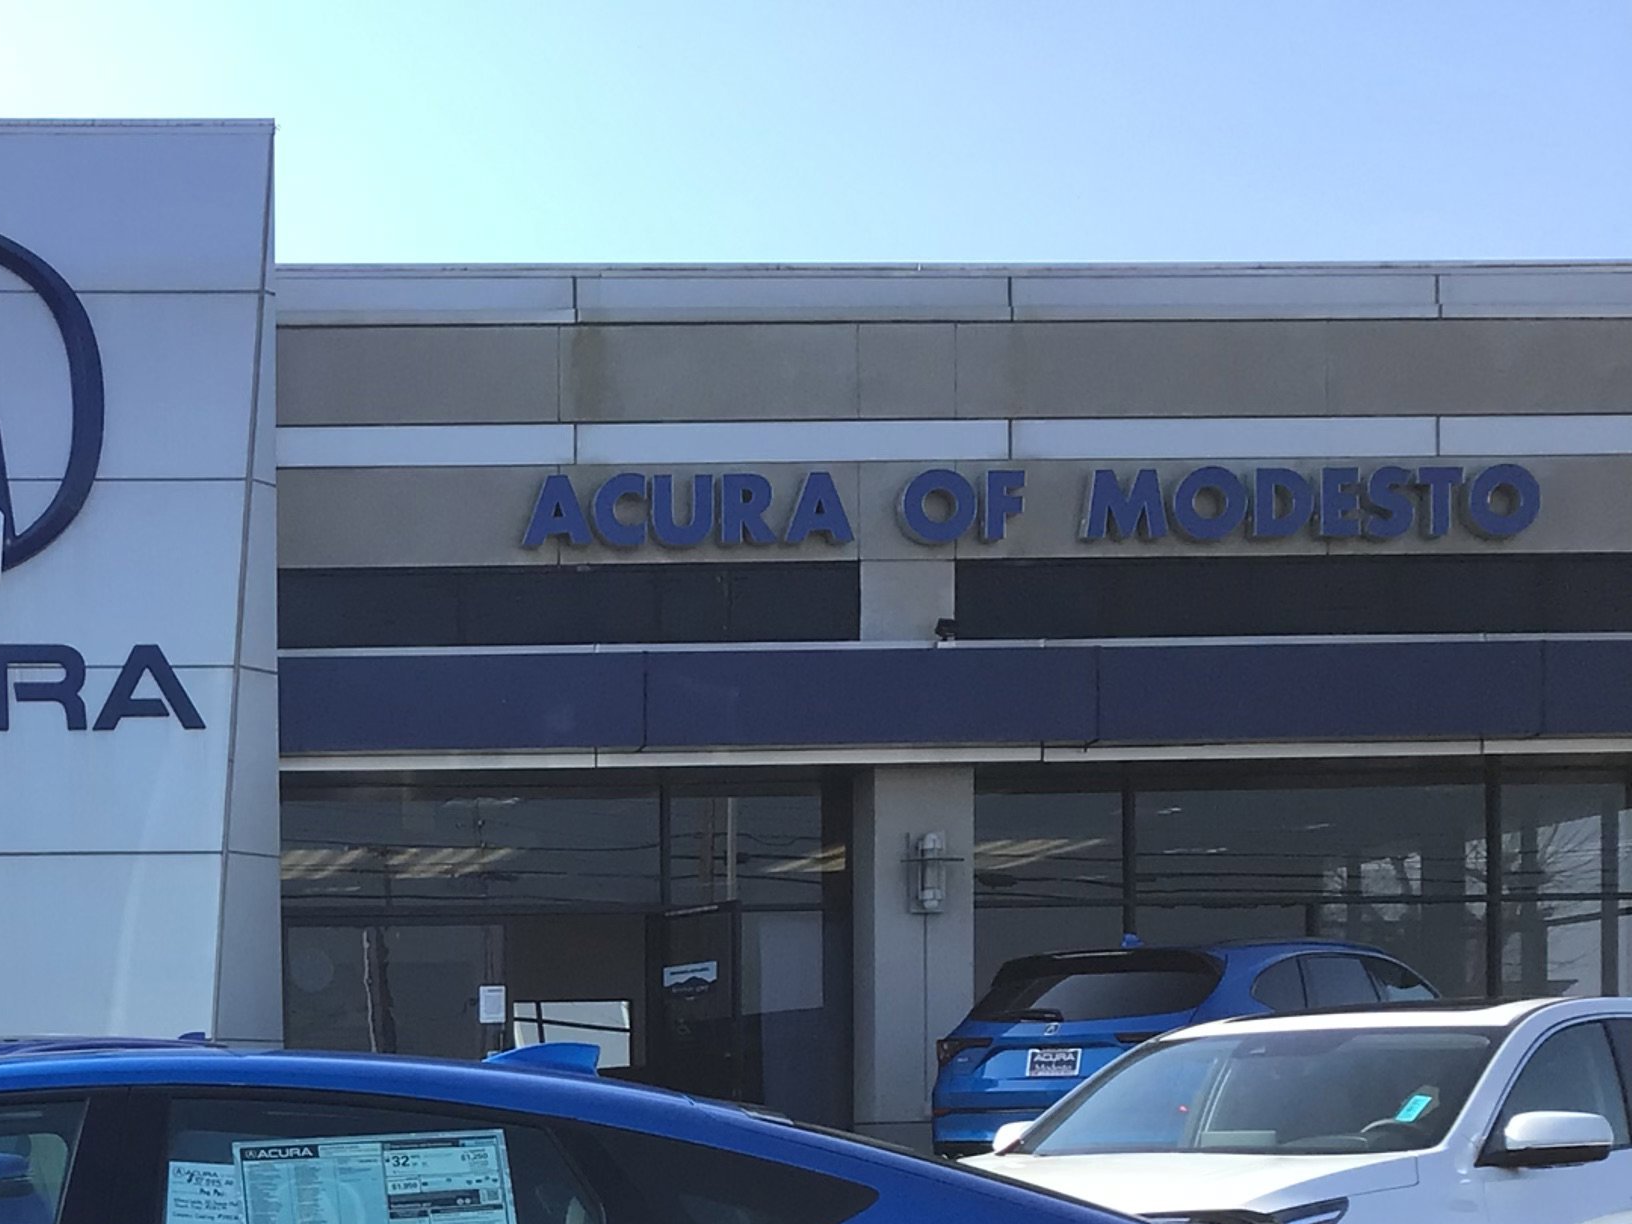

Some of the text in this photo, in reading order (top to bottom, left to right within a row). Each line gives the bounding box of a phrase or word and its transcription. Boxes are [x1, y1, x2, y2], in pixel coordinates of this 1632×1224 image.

[522, 463, 1542, 548] ACURA OF MODESTO
[1034, 1052, 1075, 1061] ACURA
[257, 1147, 314, 1159] ACURA
[391, 1155, 410, 1168] 32
